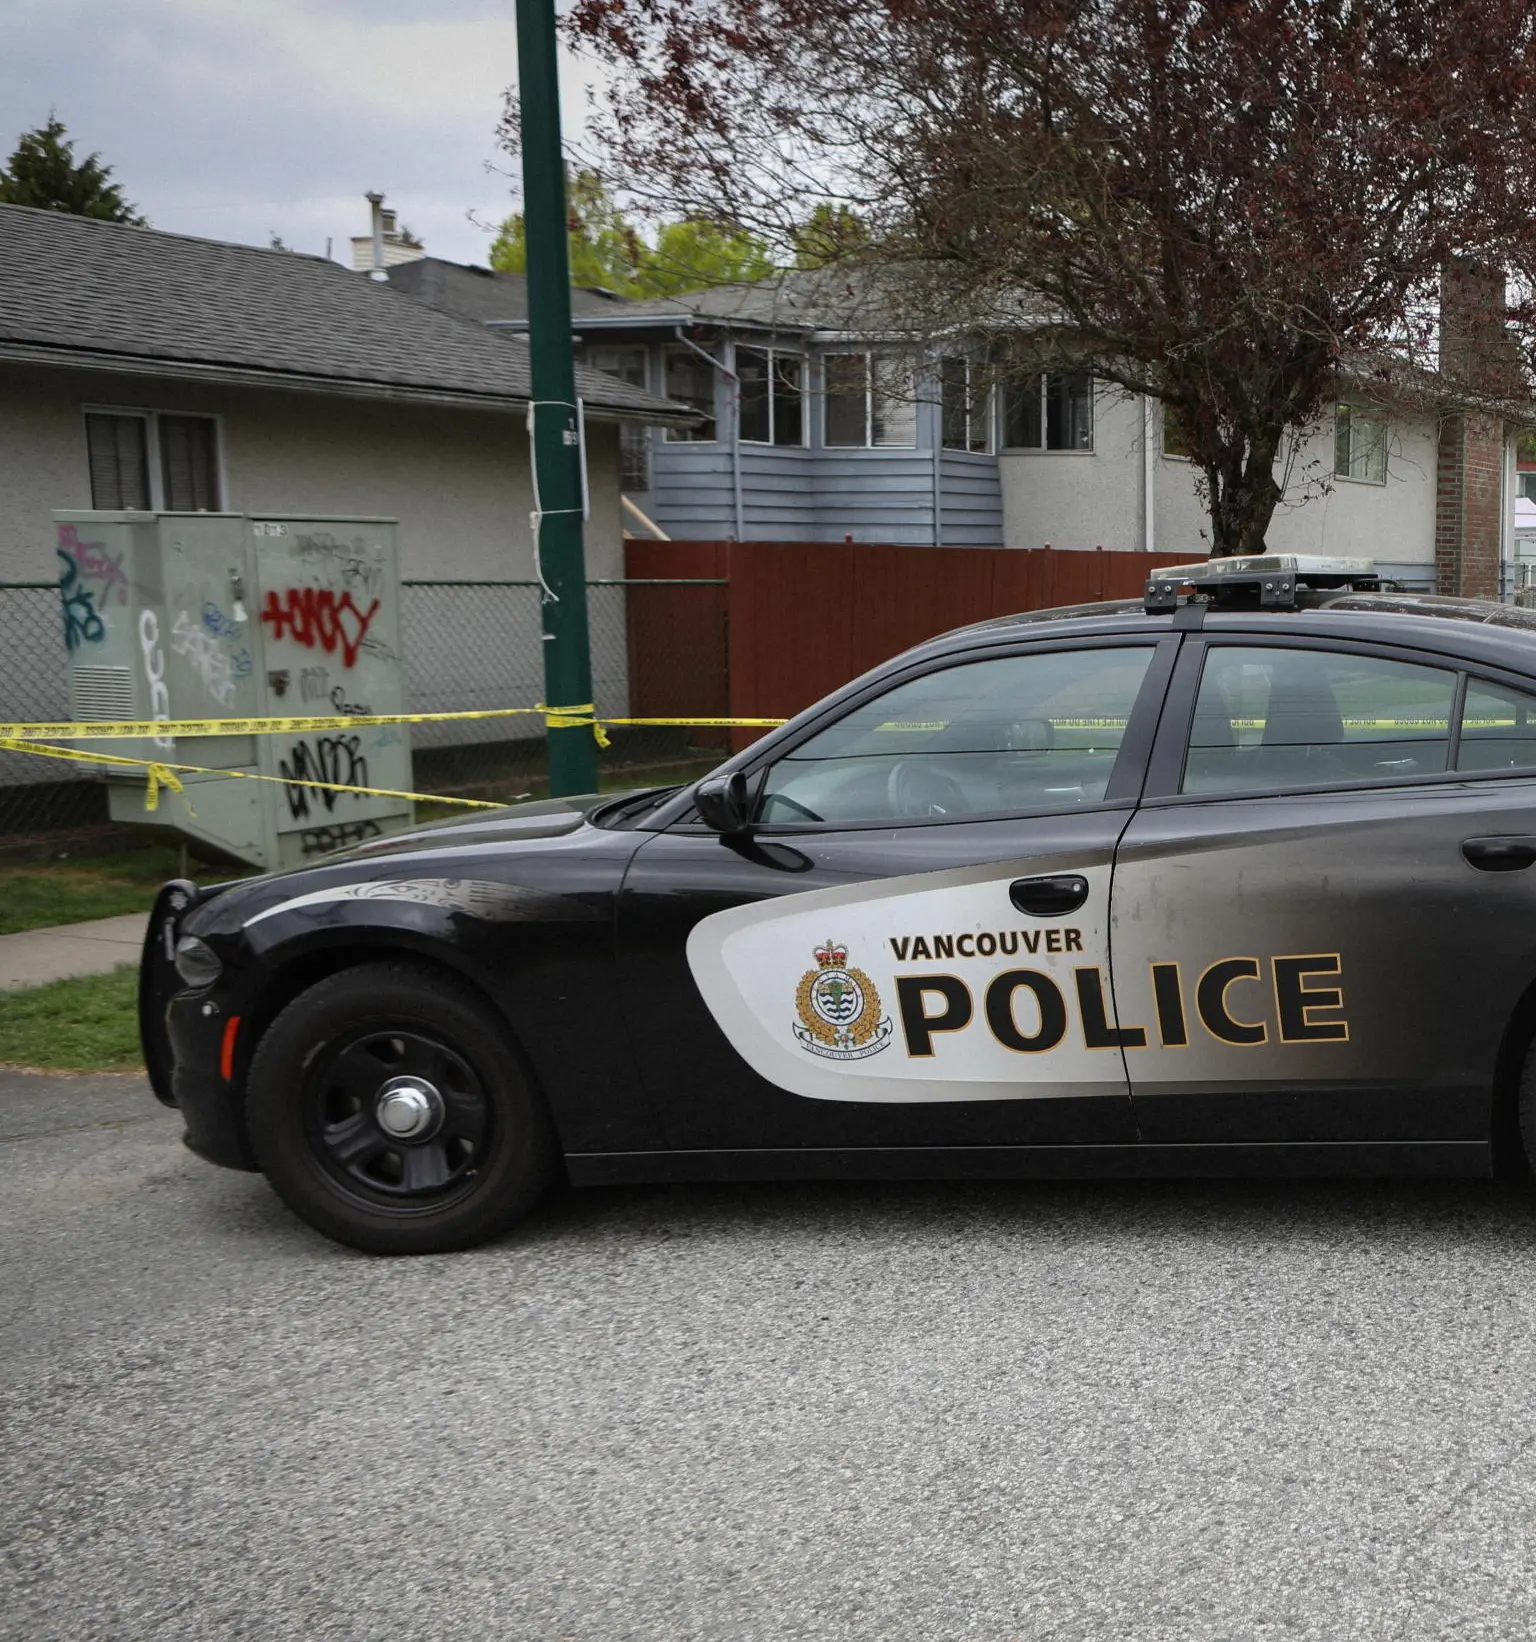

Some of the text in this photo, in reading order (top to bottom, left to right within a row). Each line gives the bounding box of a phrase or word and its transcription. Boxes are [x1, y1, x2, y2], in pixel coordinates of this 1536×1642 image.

[889, 927, 1084, 962] VANCOUVER
[893, 952, 1350, 1059] POLICE
[806, 1042, 854, 1059] VANCOUVER
